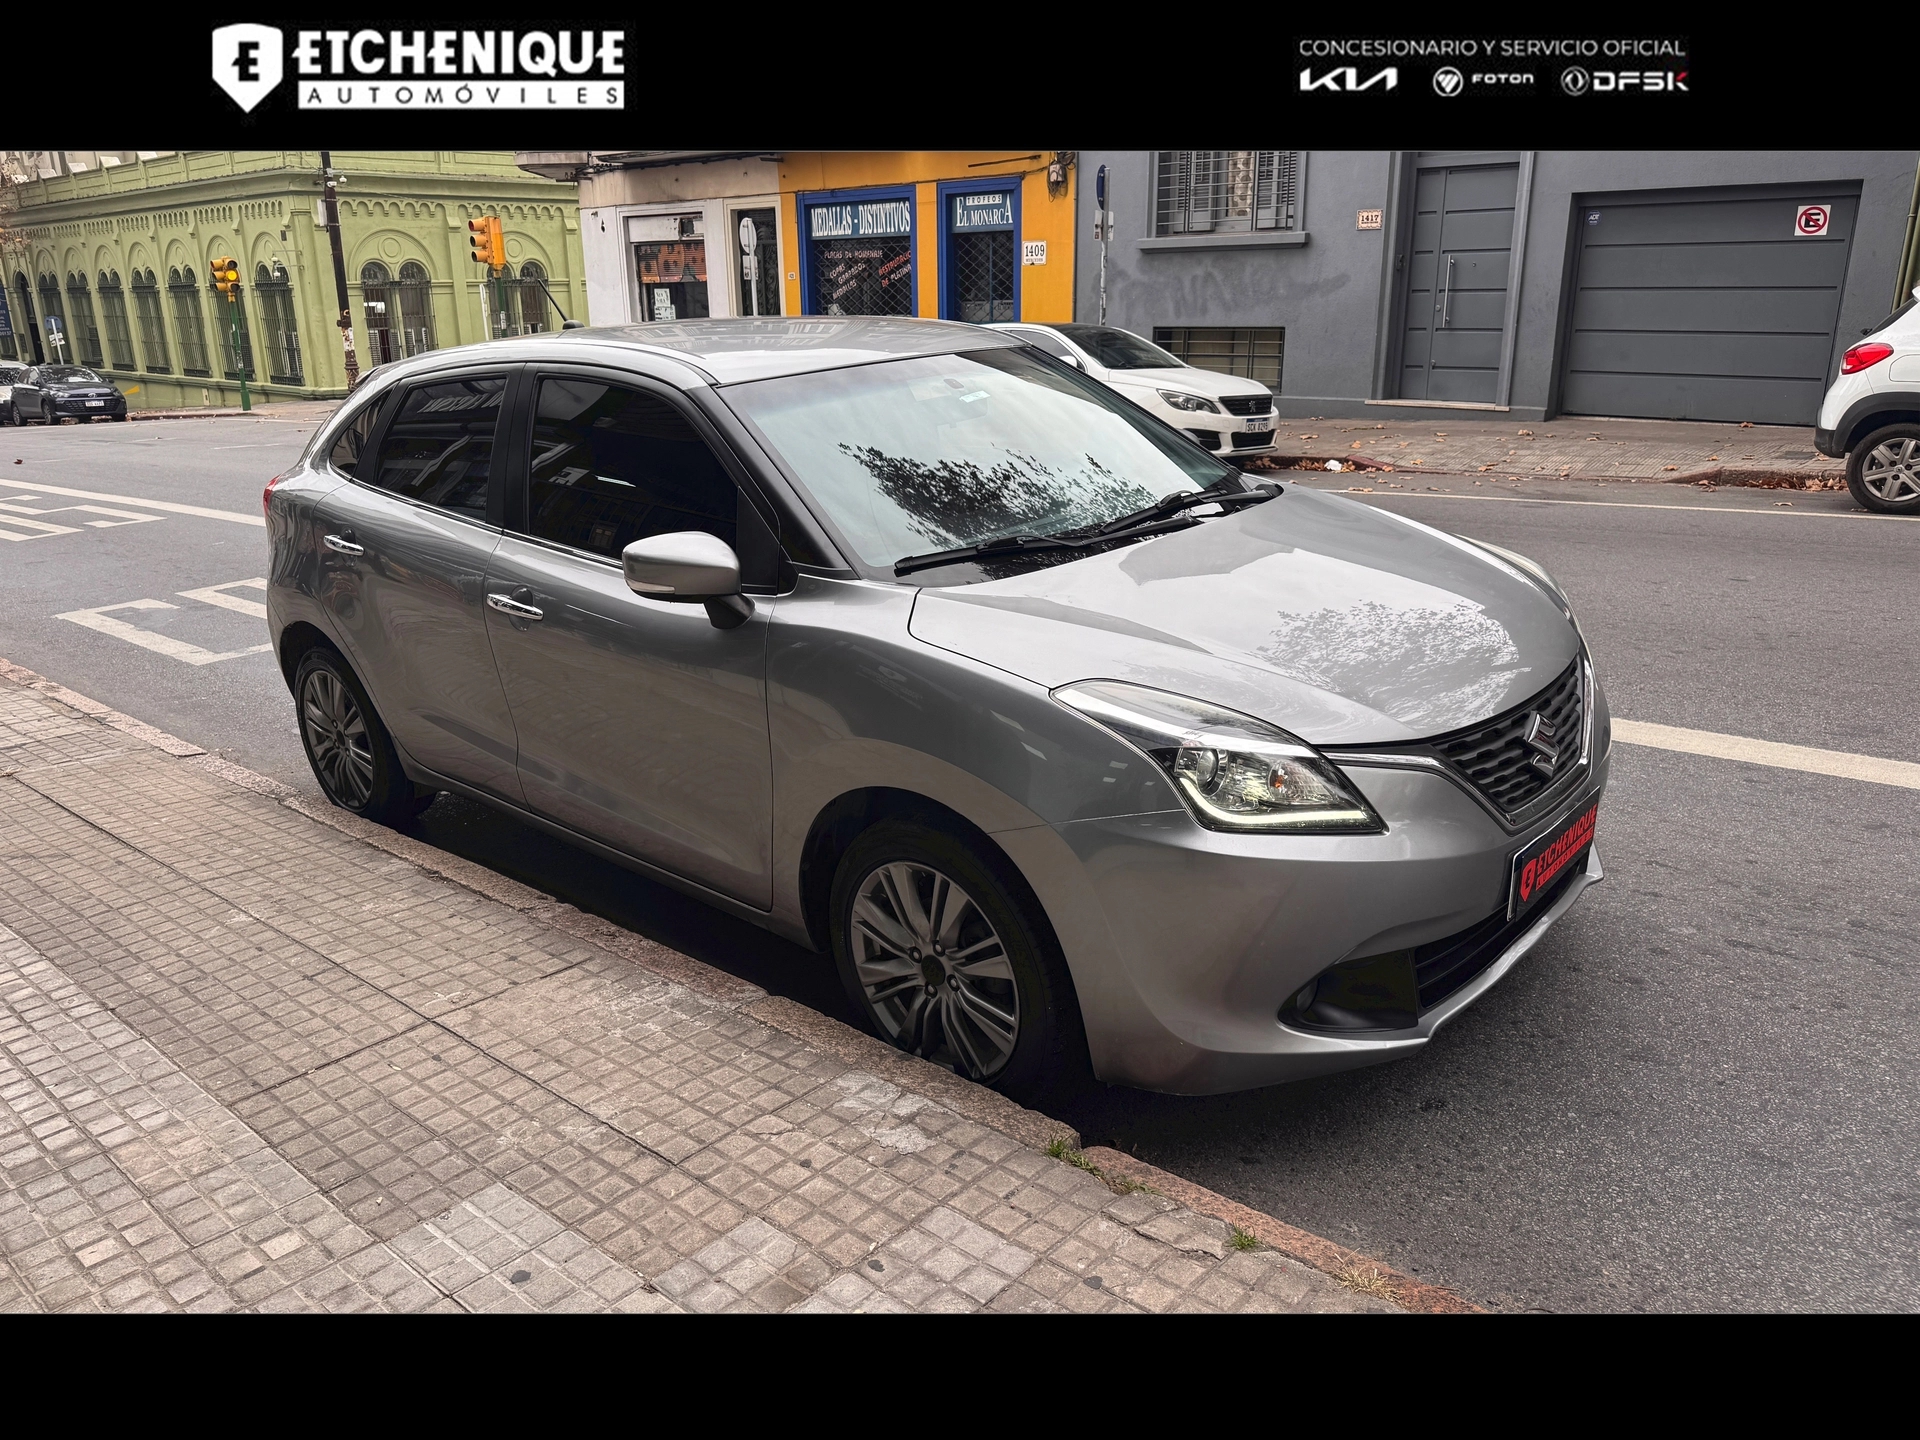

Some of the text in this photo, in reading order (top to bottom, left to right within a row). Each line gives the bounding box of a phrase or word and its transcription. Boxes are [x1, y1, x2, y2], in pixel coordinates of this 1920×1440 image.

[967, 194, 1002, 204] TROFEOS
[971, 193, 1014, 226] MONARCA
[811, 205, 852, 237] MEDALLAS
[858, 200, 911, 235] DISTINTIVOS
[1025, 244, 1045, 257] 1409
[1536, 802, 1598, 875] ETCHENIQUE
